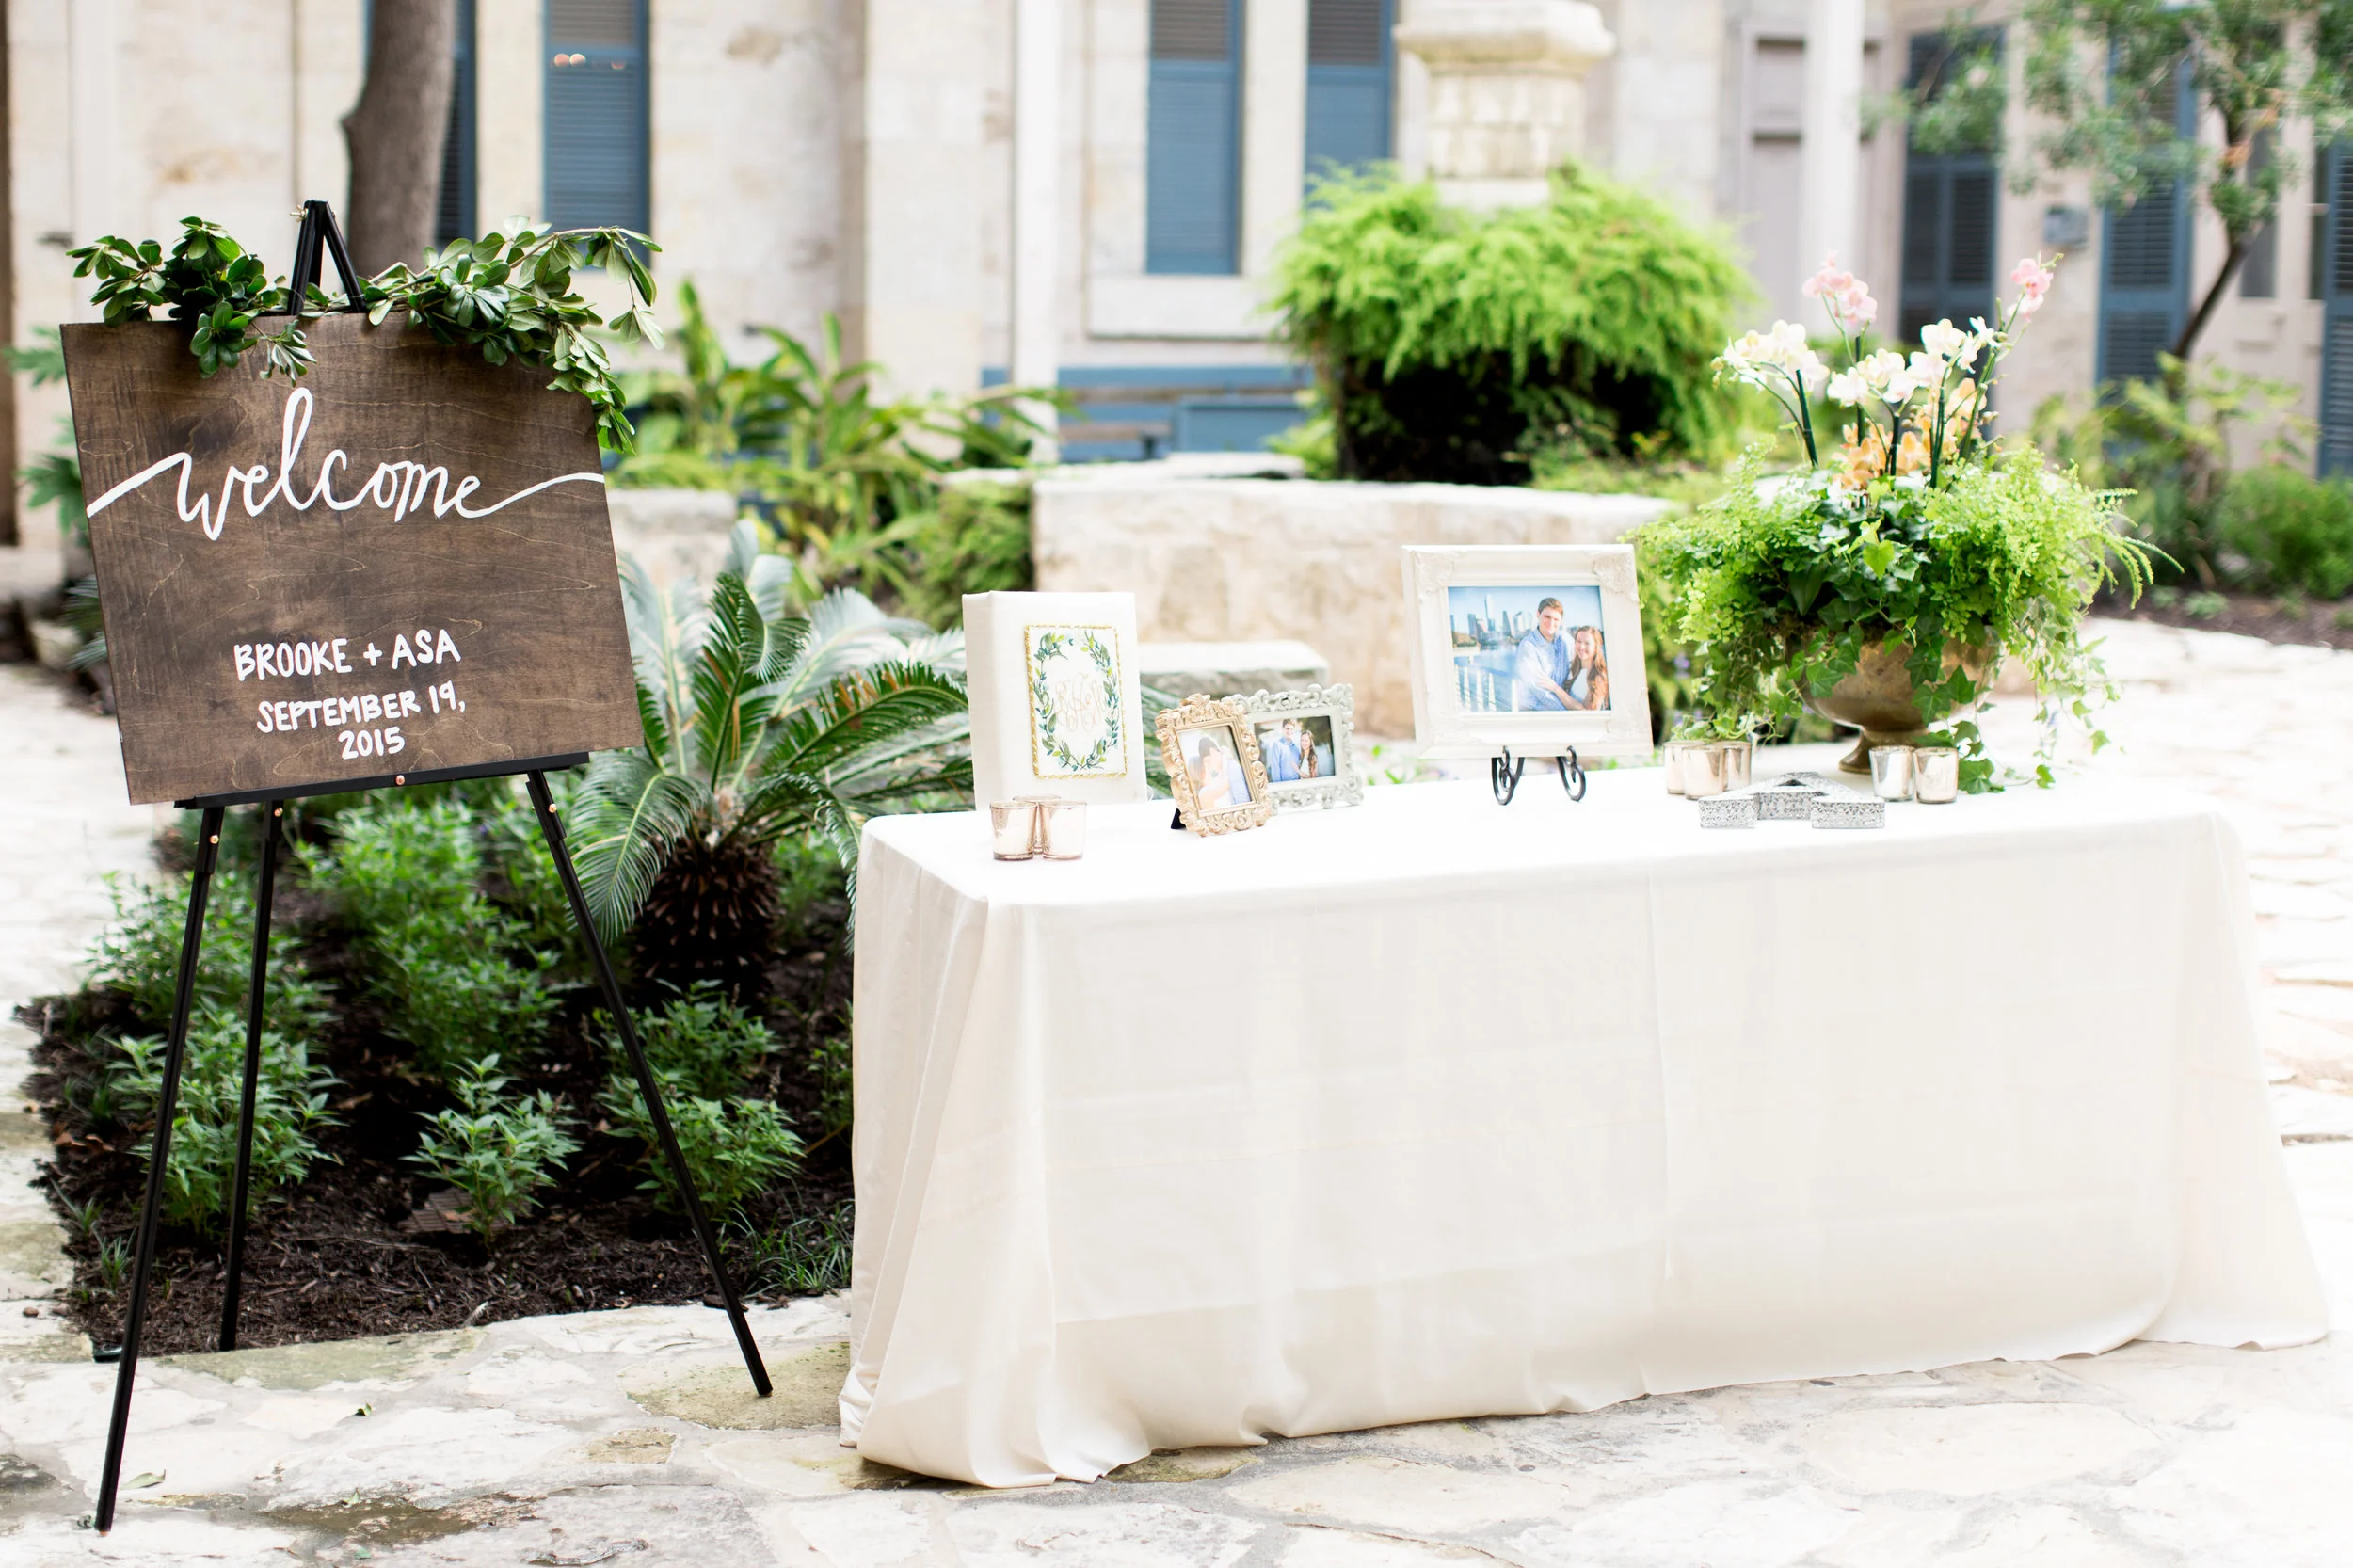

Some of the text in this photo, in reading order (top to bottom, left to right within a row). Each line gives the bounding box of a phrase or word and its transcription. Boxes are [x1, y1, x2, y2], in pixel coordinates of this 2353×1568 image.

[86, 386, 605, 541] welcome
[233, 637, 353, 682] BROOKE
[391, 628, 462, 670] ASA
[256, 680, 466, 734] SEPTEMBER 19,
[337, 726, 406, 760] 2015
